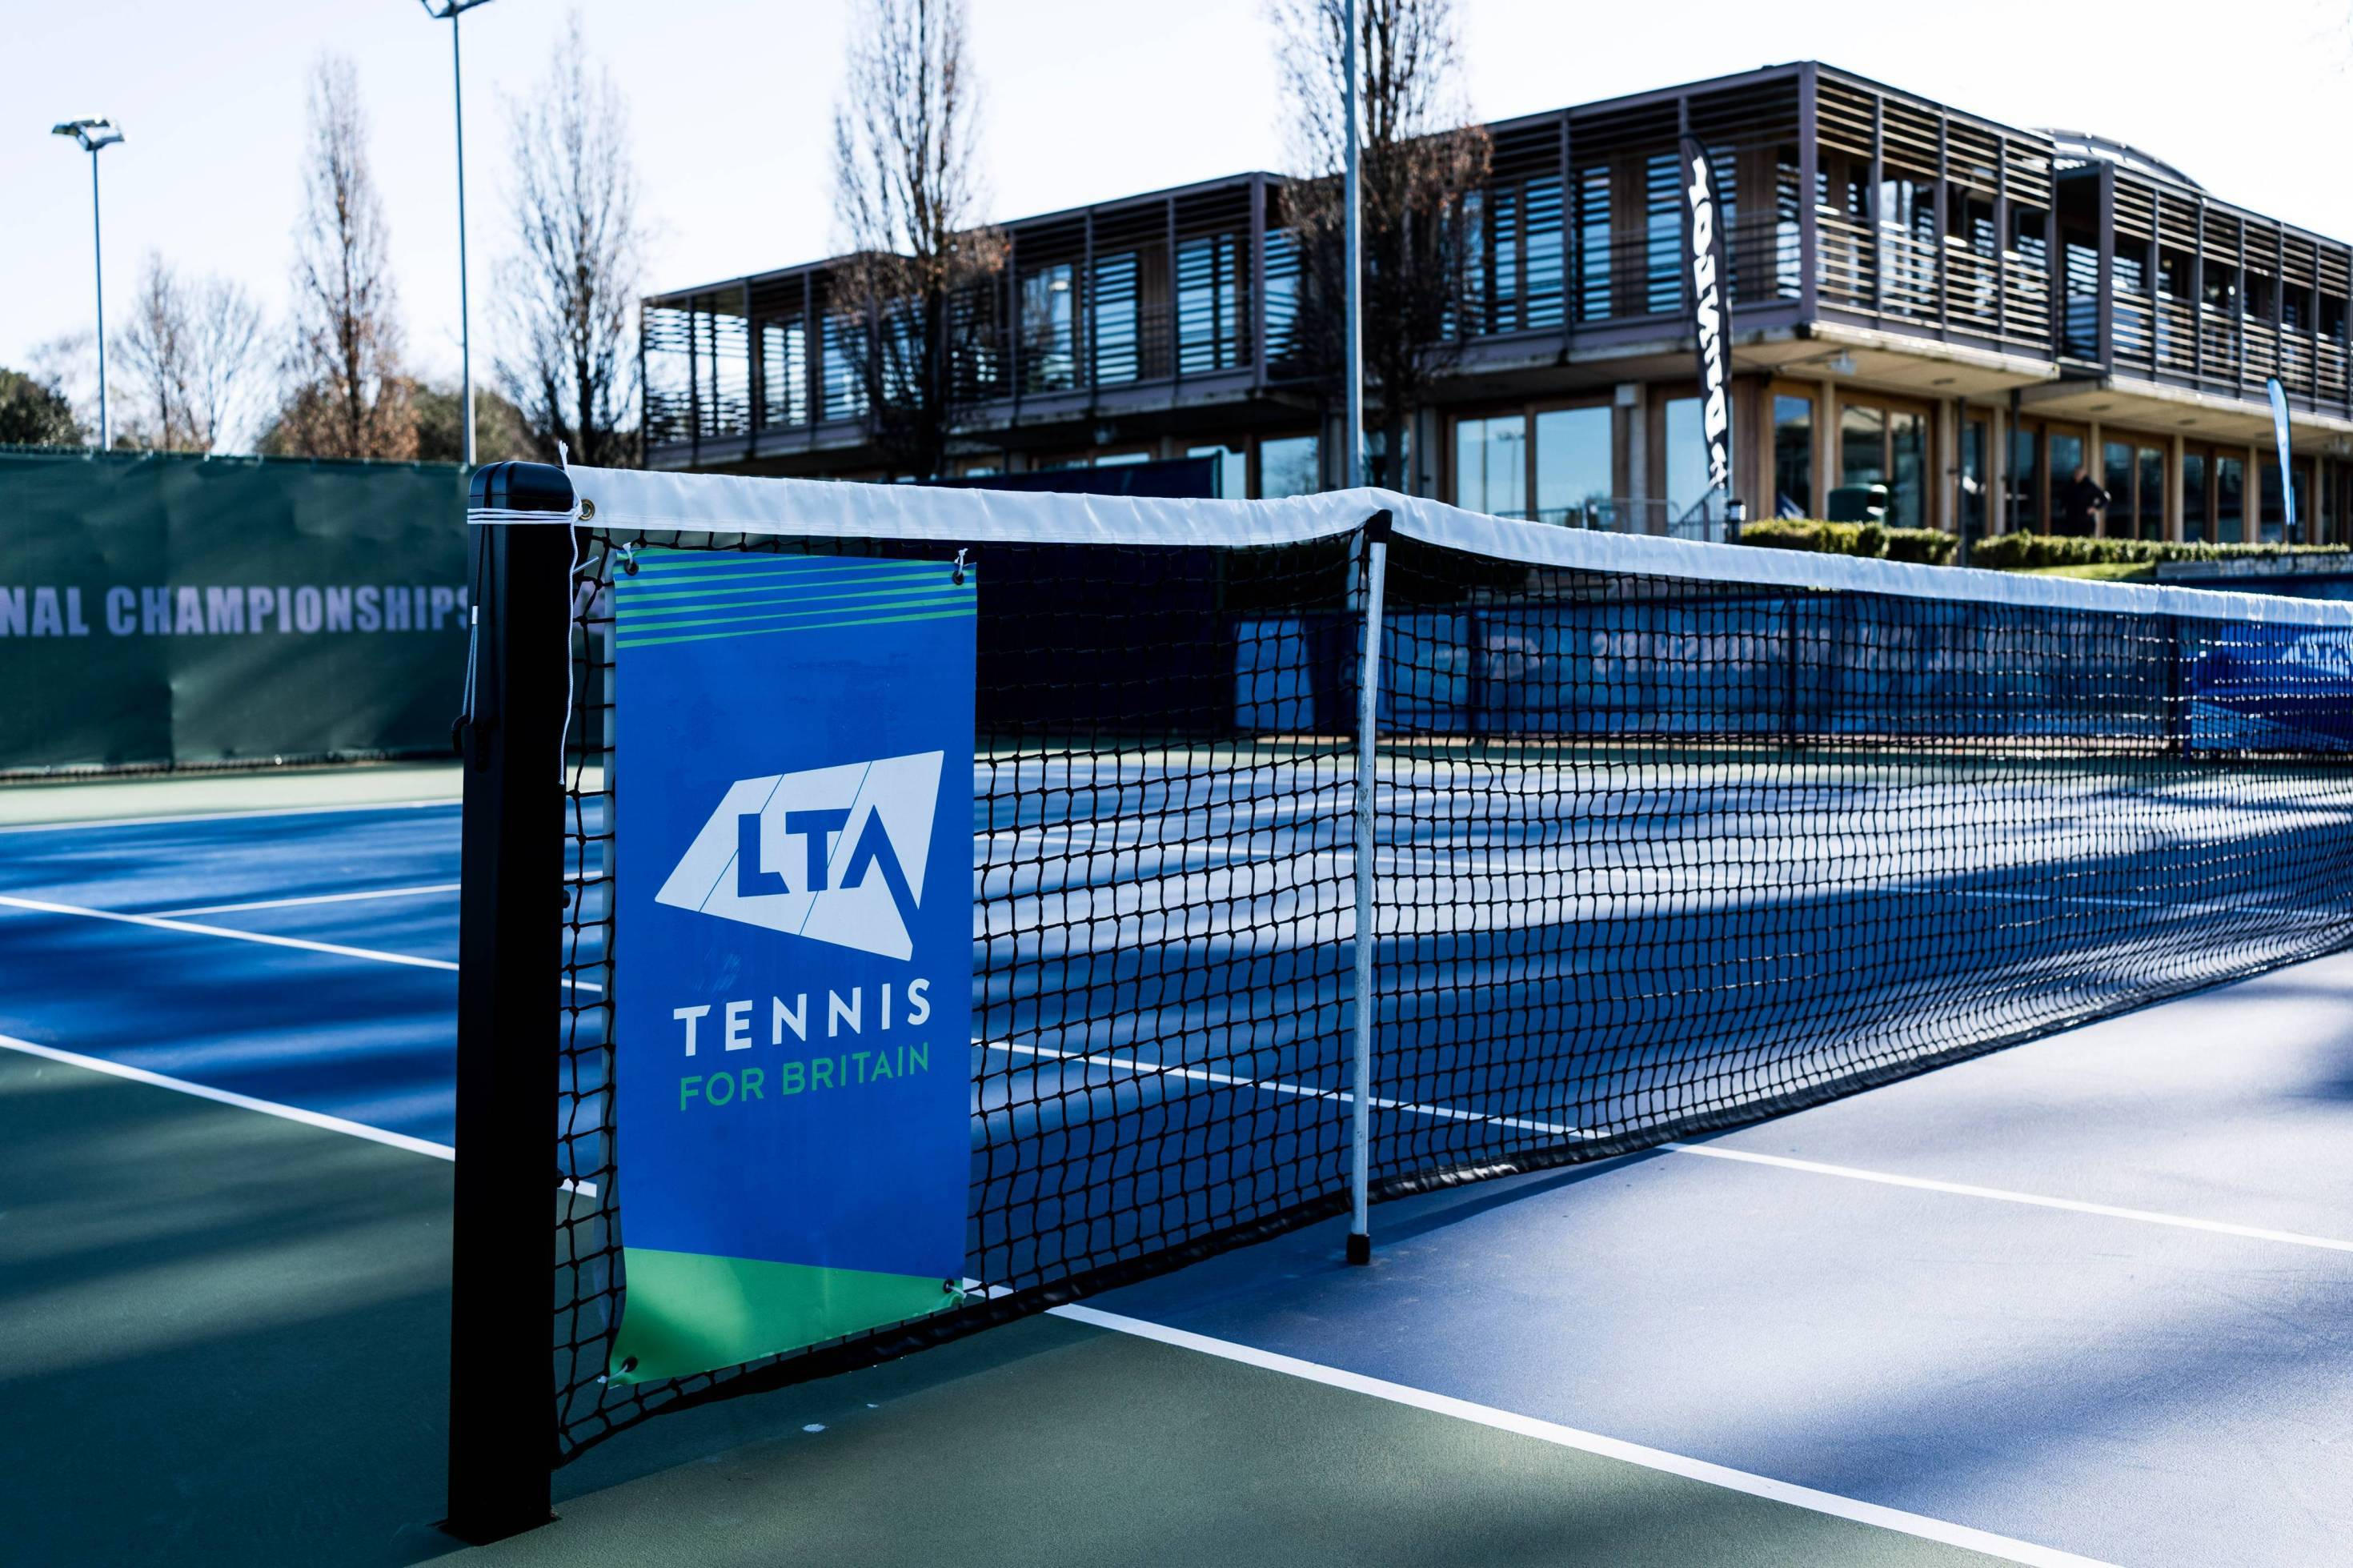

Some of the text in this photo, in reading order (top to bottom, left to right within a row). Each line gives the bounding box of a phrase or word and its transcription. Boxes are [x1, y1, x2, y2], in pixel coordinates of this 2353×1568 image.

[737, 803, 920, 912] LTA
[673, 978, 931, 1057] TENNIS
[679, 1042, 929, 1111] FOR BRITAIN
